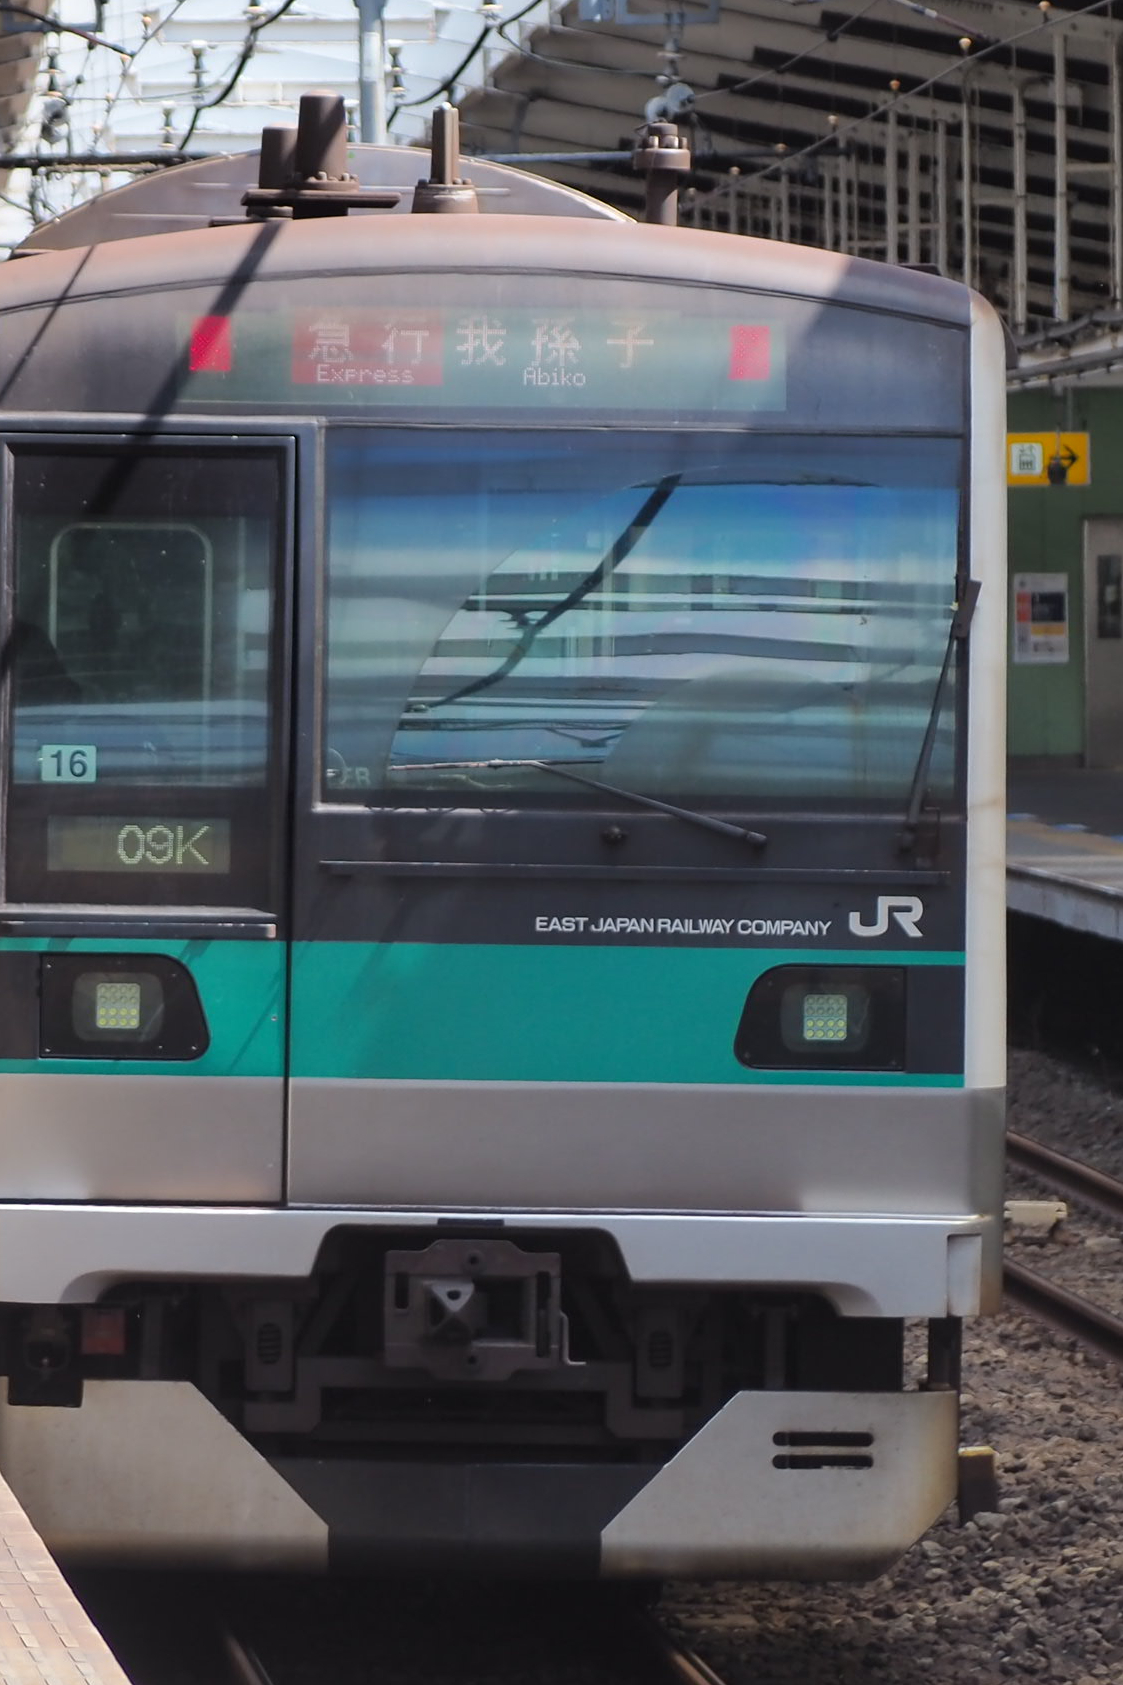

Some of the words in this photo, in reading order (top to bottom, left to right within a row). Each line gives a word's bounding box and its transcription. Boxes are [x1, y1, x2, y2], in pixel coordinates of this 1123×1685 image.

[307, 320, 430, 364] 急行
[455, 315, 654, 368] 我孫子
[316, 364, 414, 385] Express
[522, 367, 587, 388] Abiko
[50, 750, 88, 777] 16
[117, 824, 210, 865] 09K
[535, 917, 588, 932] EAST
[591, 917, 654, 933] JAPAN
[657, 918, 735, 935] RAILWAY
[737, 919, 831, 936] COMPANY
[848, 895, 924, 938] JR
